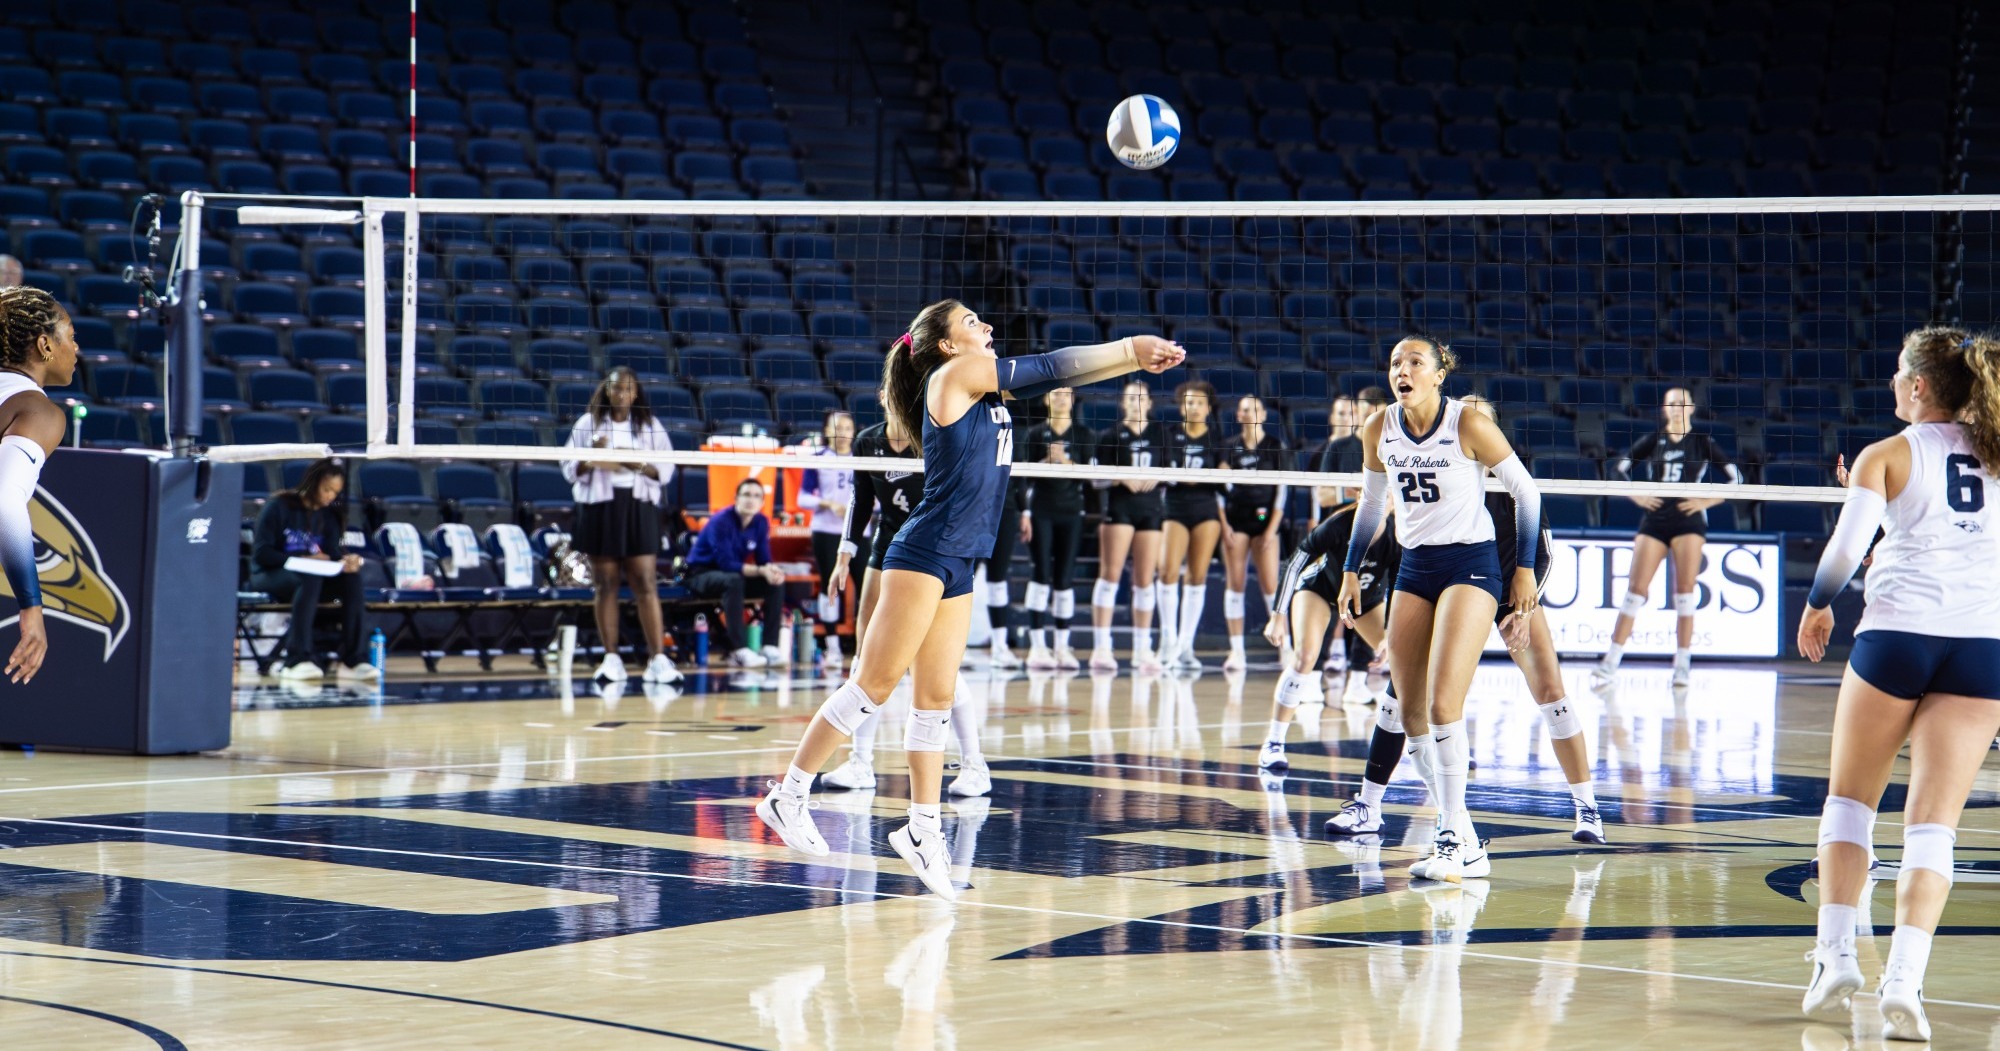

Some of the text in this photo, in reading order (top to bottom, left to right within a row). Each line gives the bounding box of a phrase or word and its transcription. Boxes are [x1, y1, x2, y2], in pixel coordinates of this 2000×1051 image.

[1387, 454, 1451, 468] Oral Roberts
[1662, 462, 1684, 482] 15
[1397, 472, 1441, 503] 25
[1946, 453, 1985, 513] 6
[892, 488, 910, 513] 4
